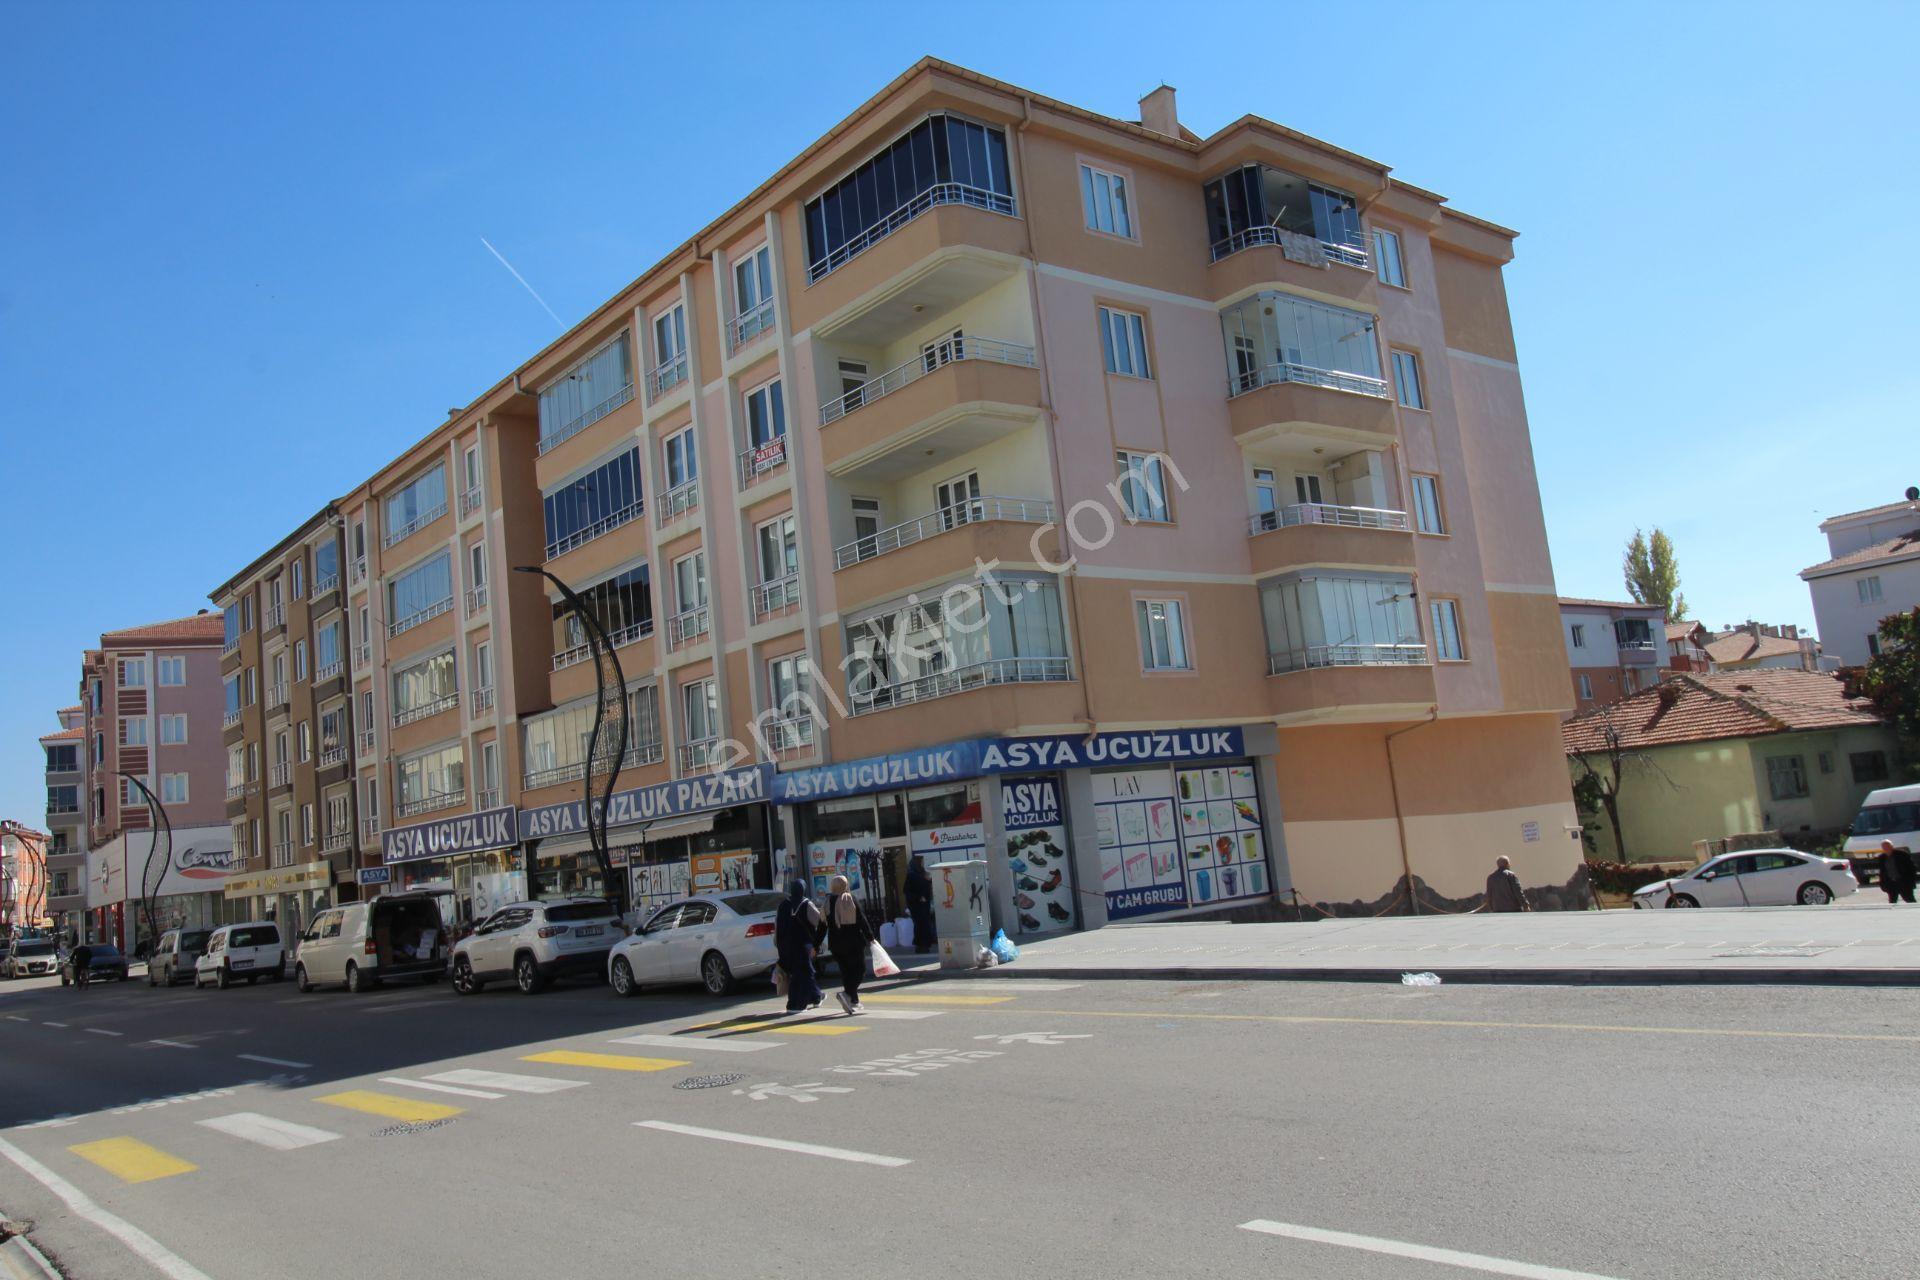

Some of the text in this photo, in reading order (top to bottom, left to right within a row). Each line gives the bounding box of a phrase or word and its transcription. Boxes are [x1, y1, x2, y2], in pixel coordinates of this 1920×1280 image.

[981, 731, 1233, 769] ASYA UCUZLUK
[784, 750, 955, 799] ASYA UCUZLUK
[529, 806, 573, 836] ASYA
[1002, 782, 1060, 827] ASYA UCUZLUK
[387, 812, 510, 860] ASYA UCUZLUK
[363, 870, 388, 880] ASYA
[1116, 892, 1143, 909] CAM
[1144, 887, 1183, 905] GRUBU
